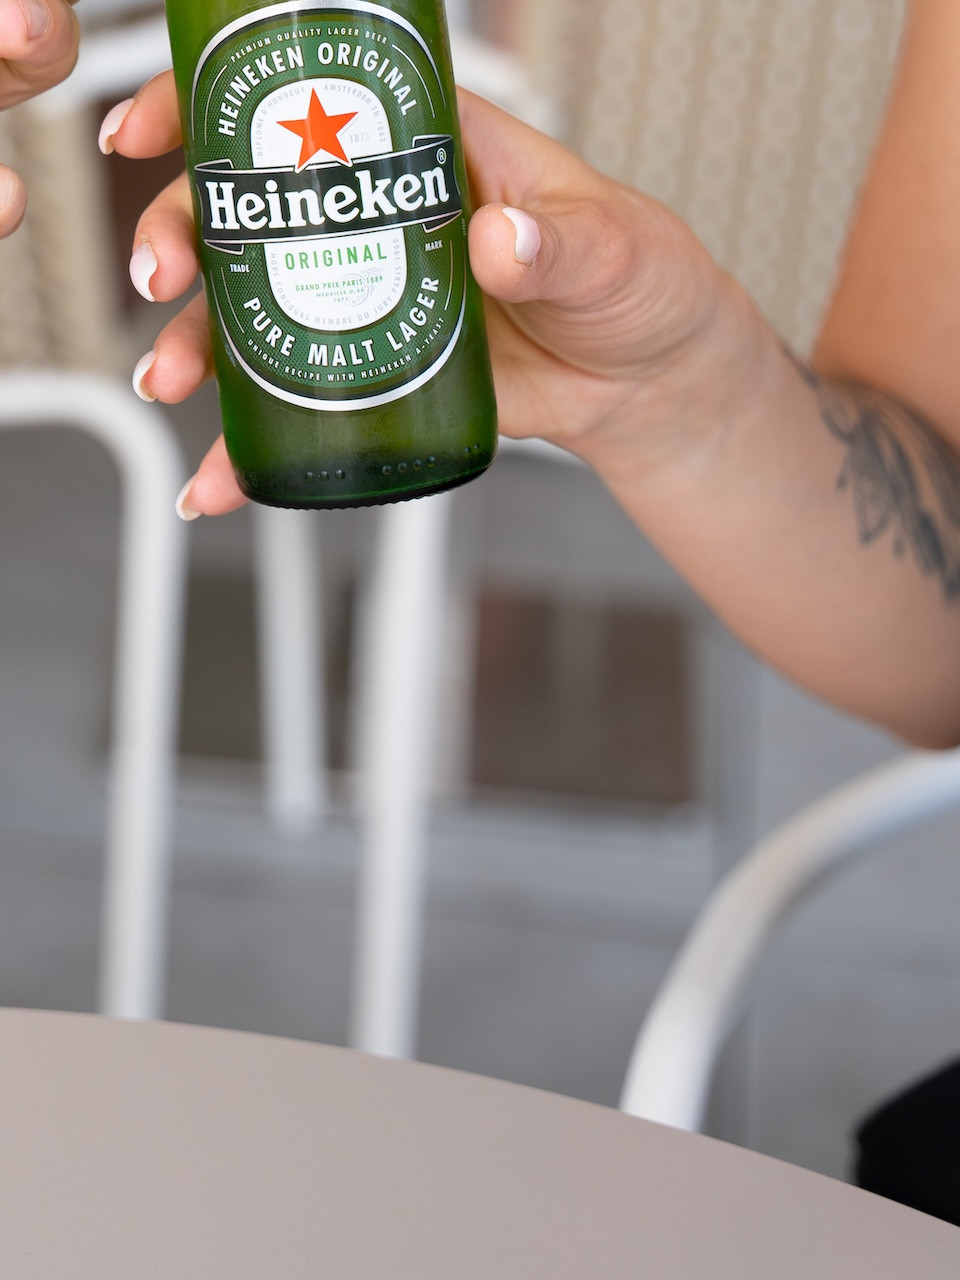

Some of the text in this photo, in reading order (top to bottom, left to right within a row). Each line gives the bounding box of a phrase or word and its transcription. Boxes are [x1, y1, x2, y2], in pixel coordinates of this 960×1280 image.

[230, 27, 388, 63] PREMIUM QUALITY LAGER BEER
[218, 42, 418, 137] HEINEKEN ORIGINAL
[324, 84, 372, 105] AMSTERDAM
[370, 105, 381, 117] EN
[285, 242, 387, 270] ORIGINAL
[425, 240, 443, 251] MARK
[230, 264, 250, 273] TRADE
[295, 275, 383, 292] GRAND PRIX PARIS 1889
[275, 282, 309, 321] CONCOURS
[357, 311, 370, 321] DU
[374, 296, 393, 314] JURY
[392, 266, 402, 294] PARIS
[243, 276, 439, 367] PURE MALT LAGER
[247, 317, 444, 382] UNIQUE RECIPE WITH HEINEKEN A-YEAST
